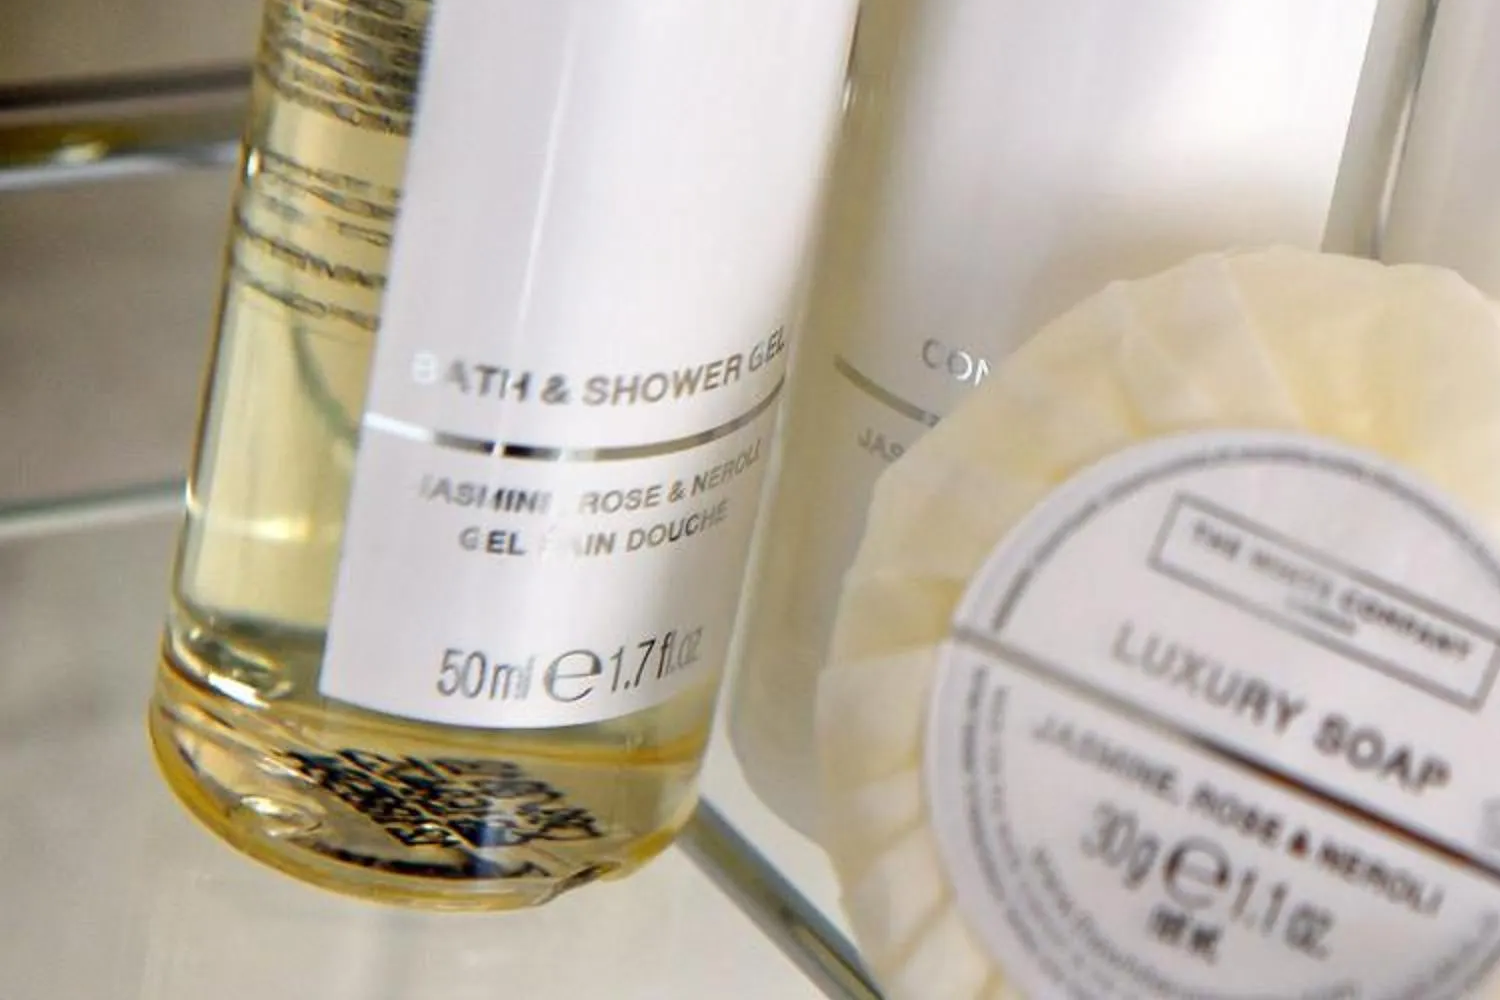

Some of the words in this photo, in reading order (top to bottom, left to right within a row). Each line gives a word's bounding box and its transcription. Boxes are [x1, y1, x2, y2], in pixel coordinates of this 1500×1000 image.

[412, 349, 534, 400] BATH
[540, 373, 574, 406] &
[582, 351, 743, 407] SHOWER
[748, 324, 786, 374] GEL
[578, 483, 663, 516] ROSE
[667, 478, 688, 505] &
[689, 437, 764, 498] NEROLI
[458, 526, 528, 557] GEL
[625, 498, 731, 554] DOUCHE
[435, 646, 536, 702] 50ml
[1111, 618, 1310, 736] LUXURY
[1313, 711, 1453, 798] SOAP
[1187, 779, 1284, 849] ROSE
[1316, 835, 1448, 919] NEROLI
